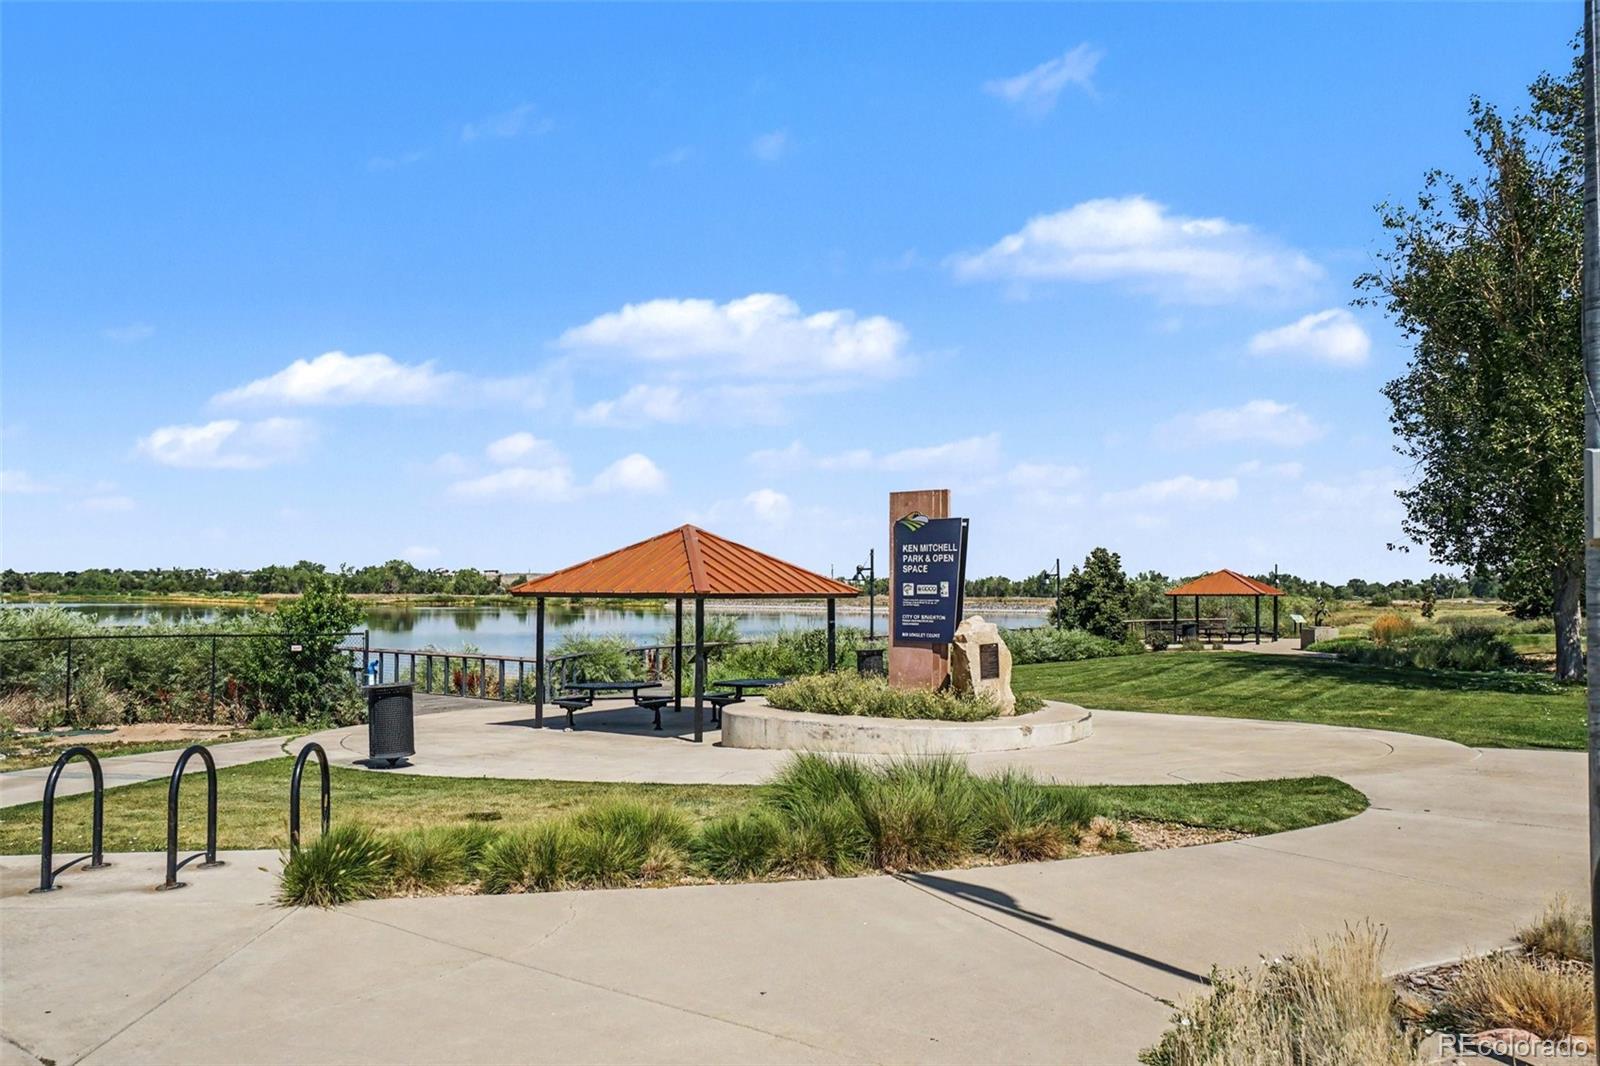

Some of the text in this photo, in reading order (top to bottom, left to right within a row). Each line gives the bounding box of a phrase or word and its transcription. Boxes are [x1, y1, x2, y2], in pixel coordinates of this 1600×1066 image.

[902, 543, 957, 552] KEN MITCHELL
[902, 553, 954, 562] PARK & OPEN
[902, 564, 928, 573] SPACE
